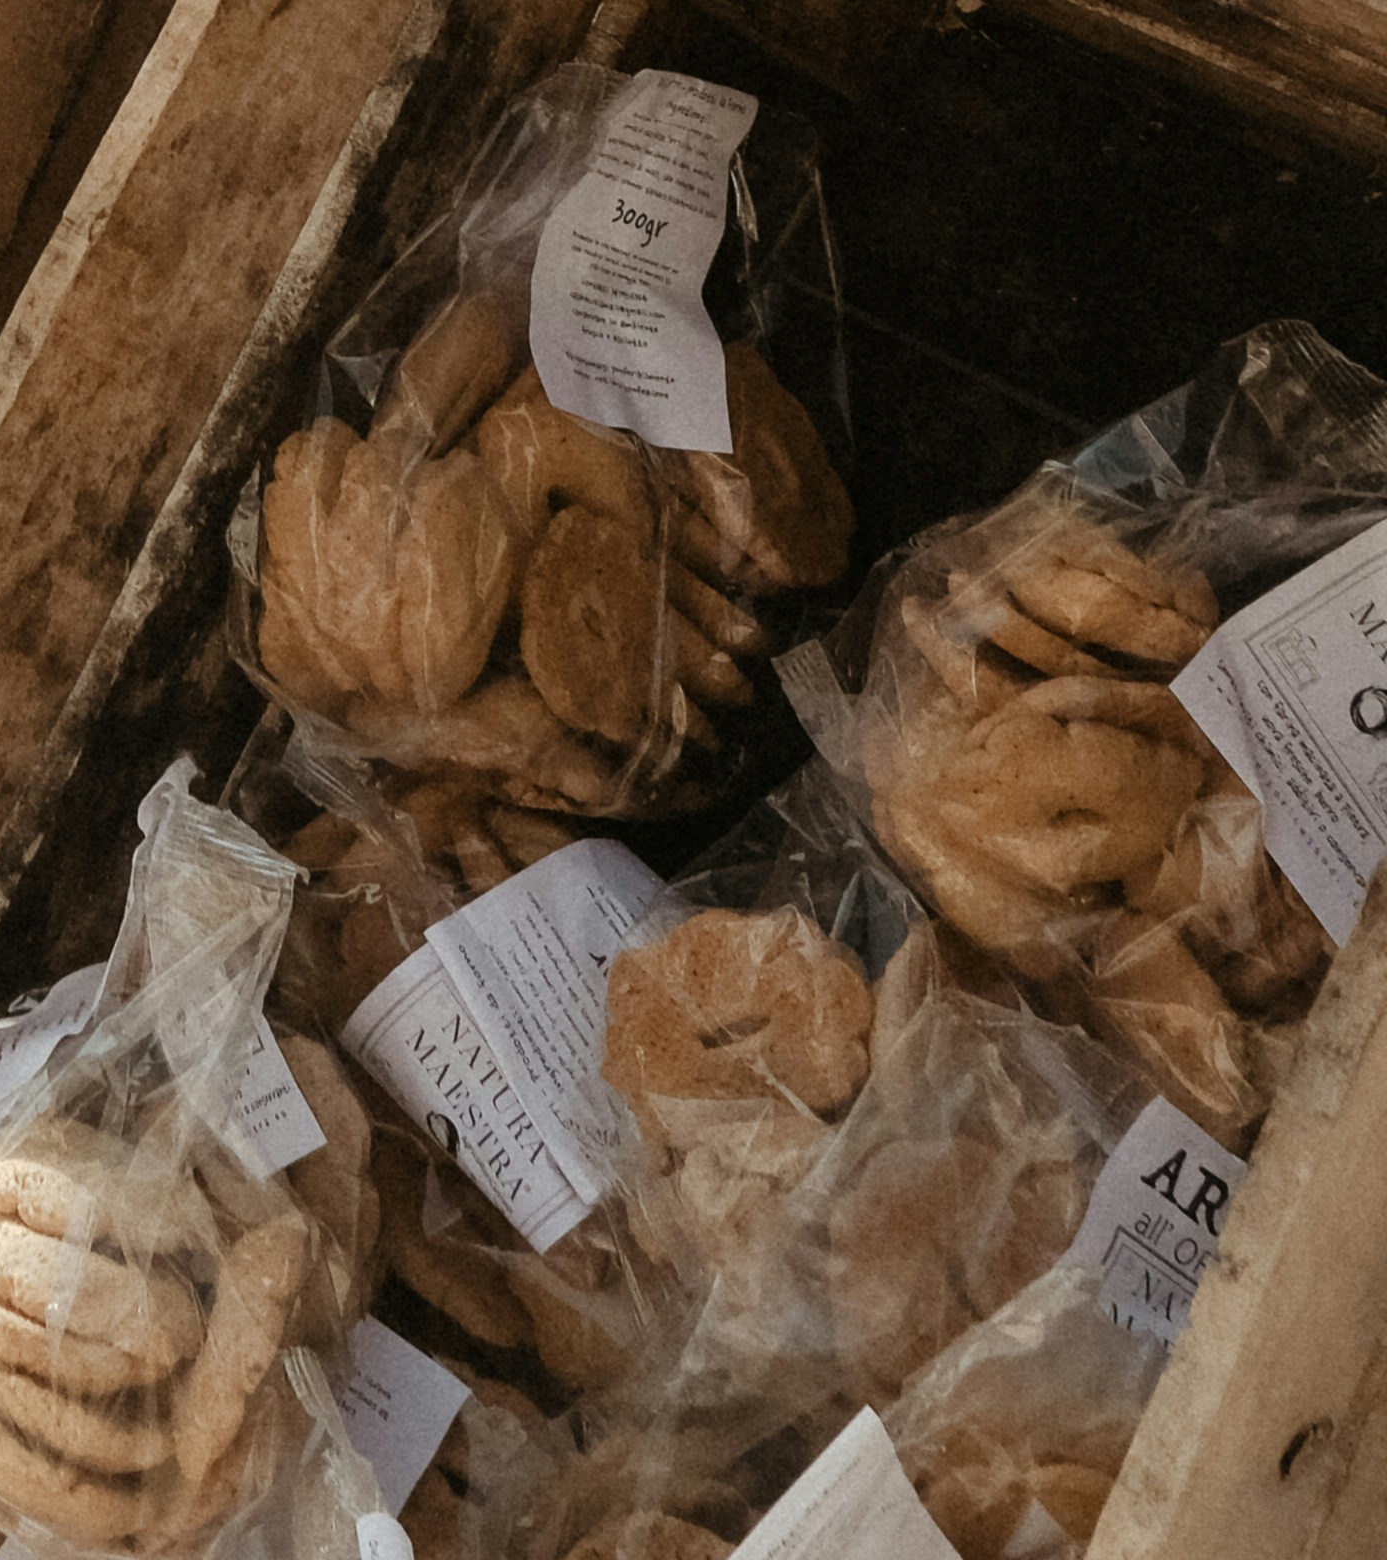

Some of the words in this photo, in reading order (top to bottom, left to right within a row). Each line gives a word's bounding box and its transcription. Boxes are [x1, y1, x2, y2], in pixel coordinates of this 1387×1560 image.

[612, 198, 670, 248] 300gr
[405, 1028, 523, 1201] MAESTRA
[442, 1014, 545, 1164] NATURA
